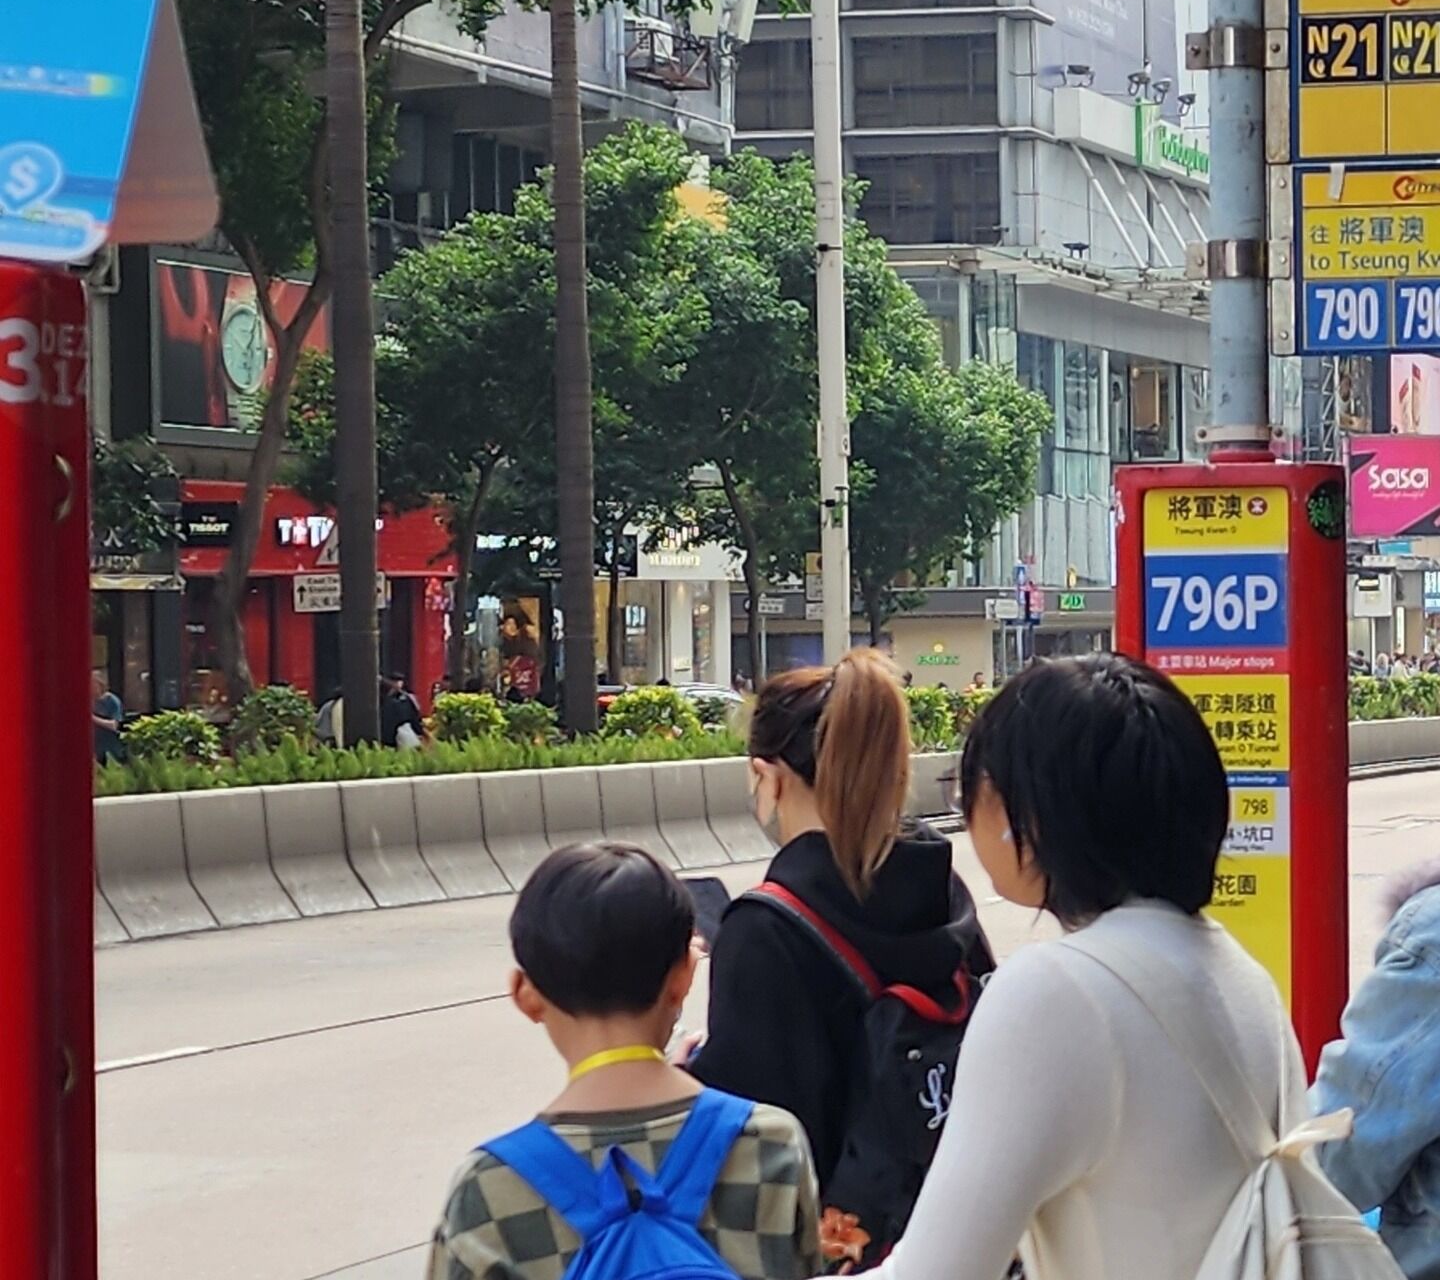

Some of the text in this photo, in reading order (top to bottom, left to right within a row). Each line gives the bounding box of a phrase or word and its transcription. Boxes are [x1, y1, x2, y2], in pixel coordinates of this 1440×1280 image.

[1307, 22, 1378, 78] N21
[1310, 215, 1425, 245] 往 將軍澳
[1310, 253, 1331, 271] to
[1337, 250, 1411, 276] Tseung
[1315, 287, 1380, 341] 790
[1168, 493, 1243, 521] 將軍澳
[1151, 574, 1279, 632] 796P
[1208, 654, 1242, 671] Major
[1243, 656, 1275, 670] stops
[1207, 719, 1278, 741] 轉乘站
[1247, 742, 1280, 753] Tunnel
[1242, 798, 1269, 816] 798
